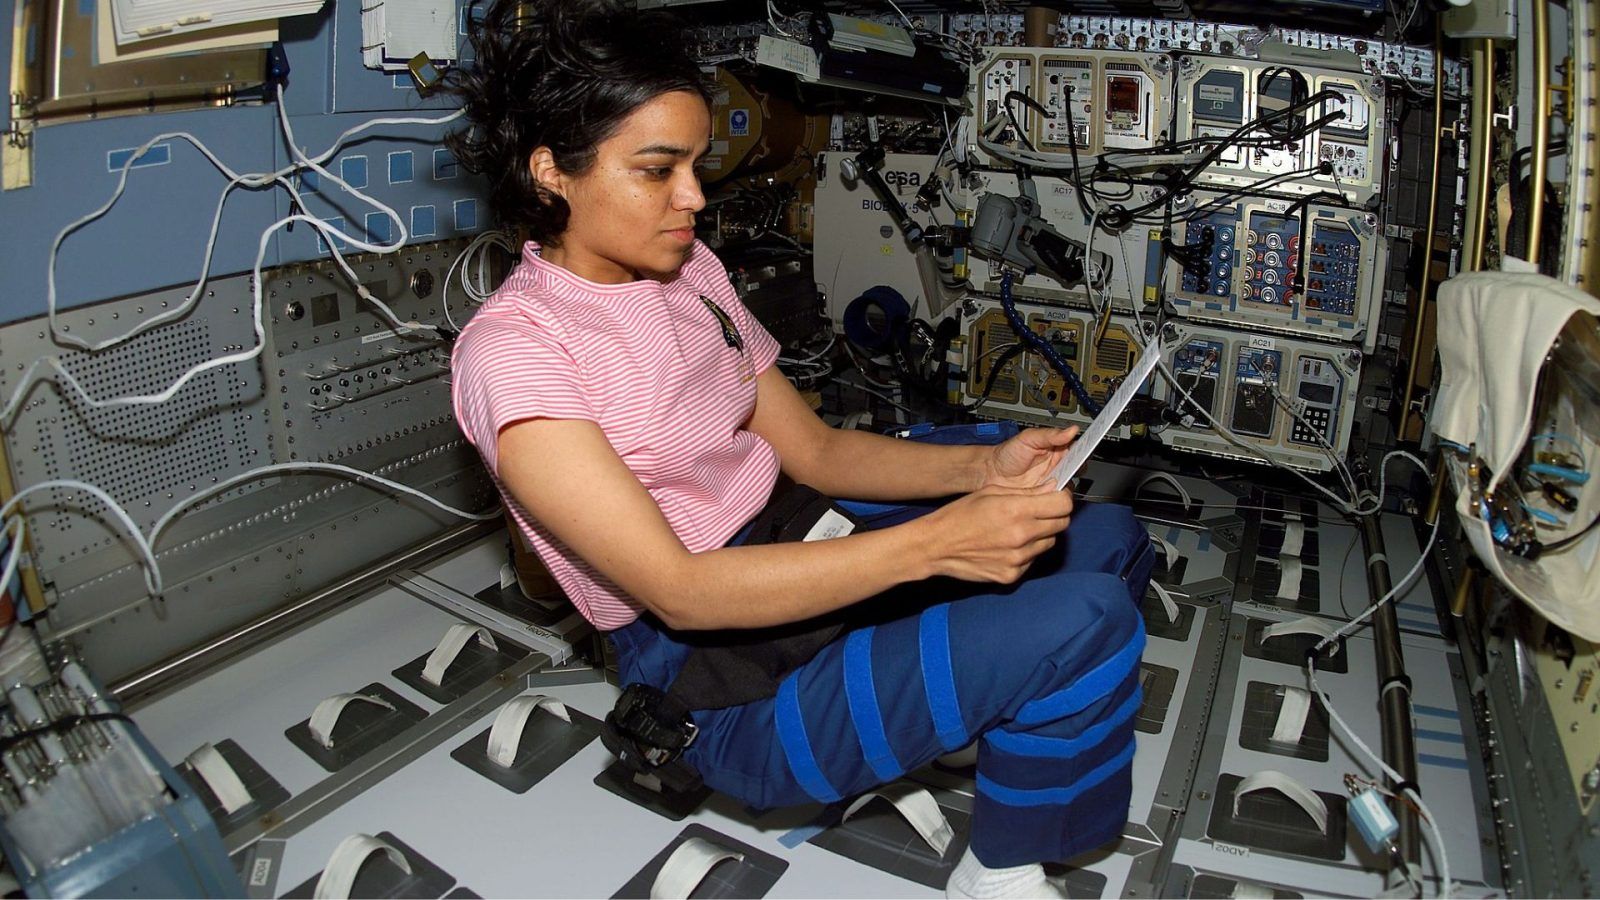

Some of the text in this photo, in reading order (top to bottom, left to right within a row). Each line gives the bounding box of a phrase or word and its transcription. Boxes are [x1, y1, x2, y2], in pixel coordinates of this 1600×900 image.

[885, 171, 920, 186] esa
[1267, 202, 1286, 211] AC18
[1047, 311, 1066, 319] AC20
[1252, 338, 1271, 347] AC21
[1215, 843, 1246, 856] AD02
[253, 860, 268, 883] AD04
